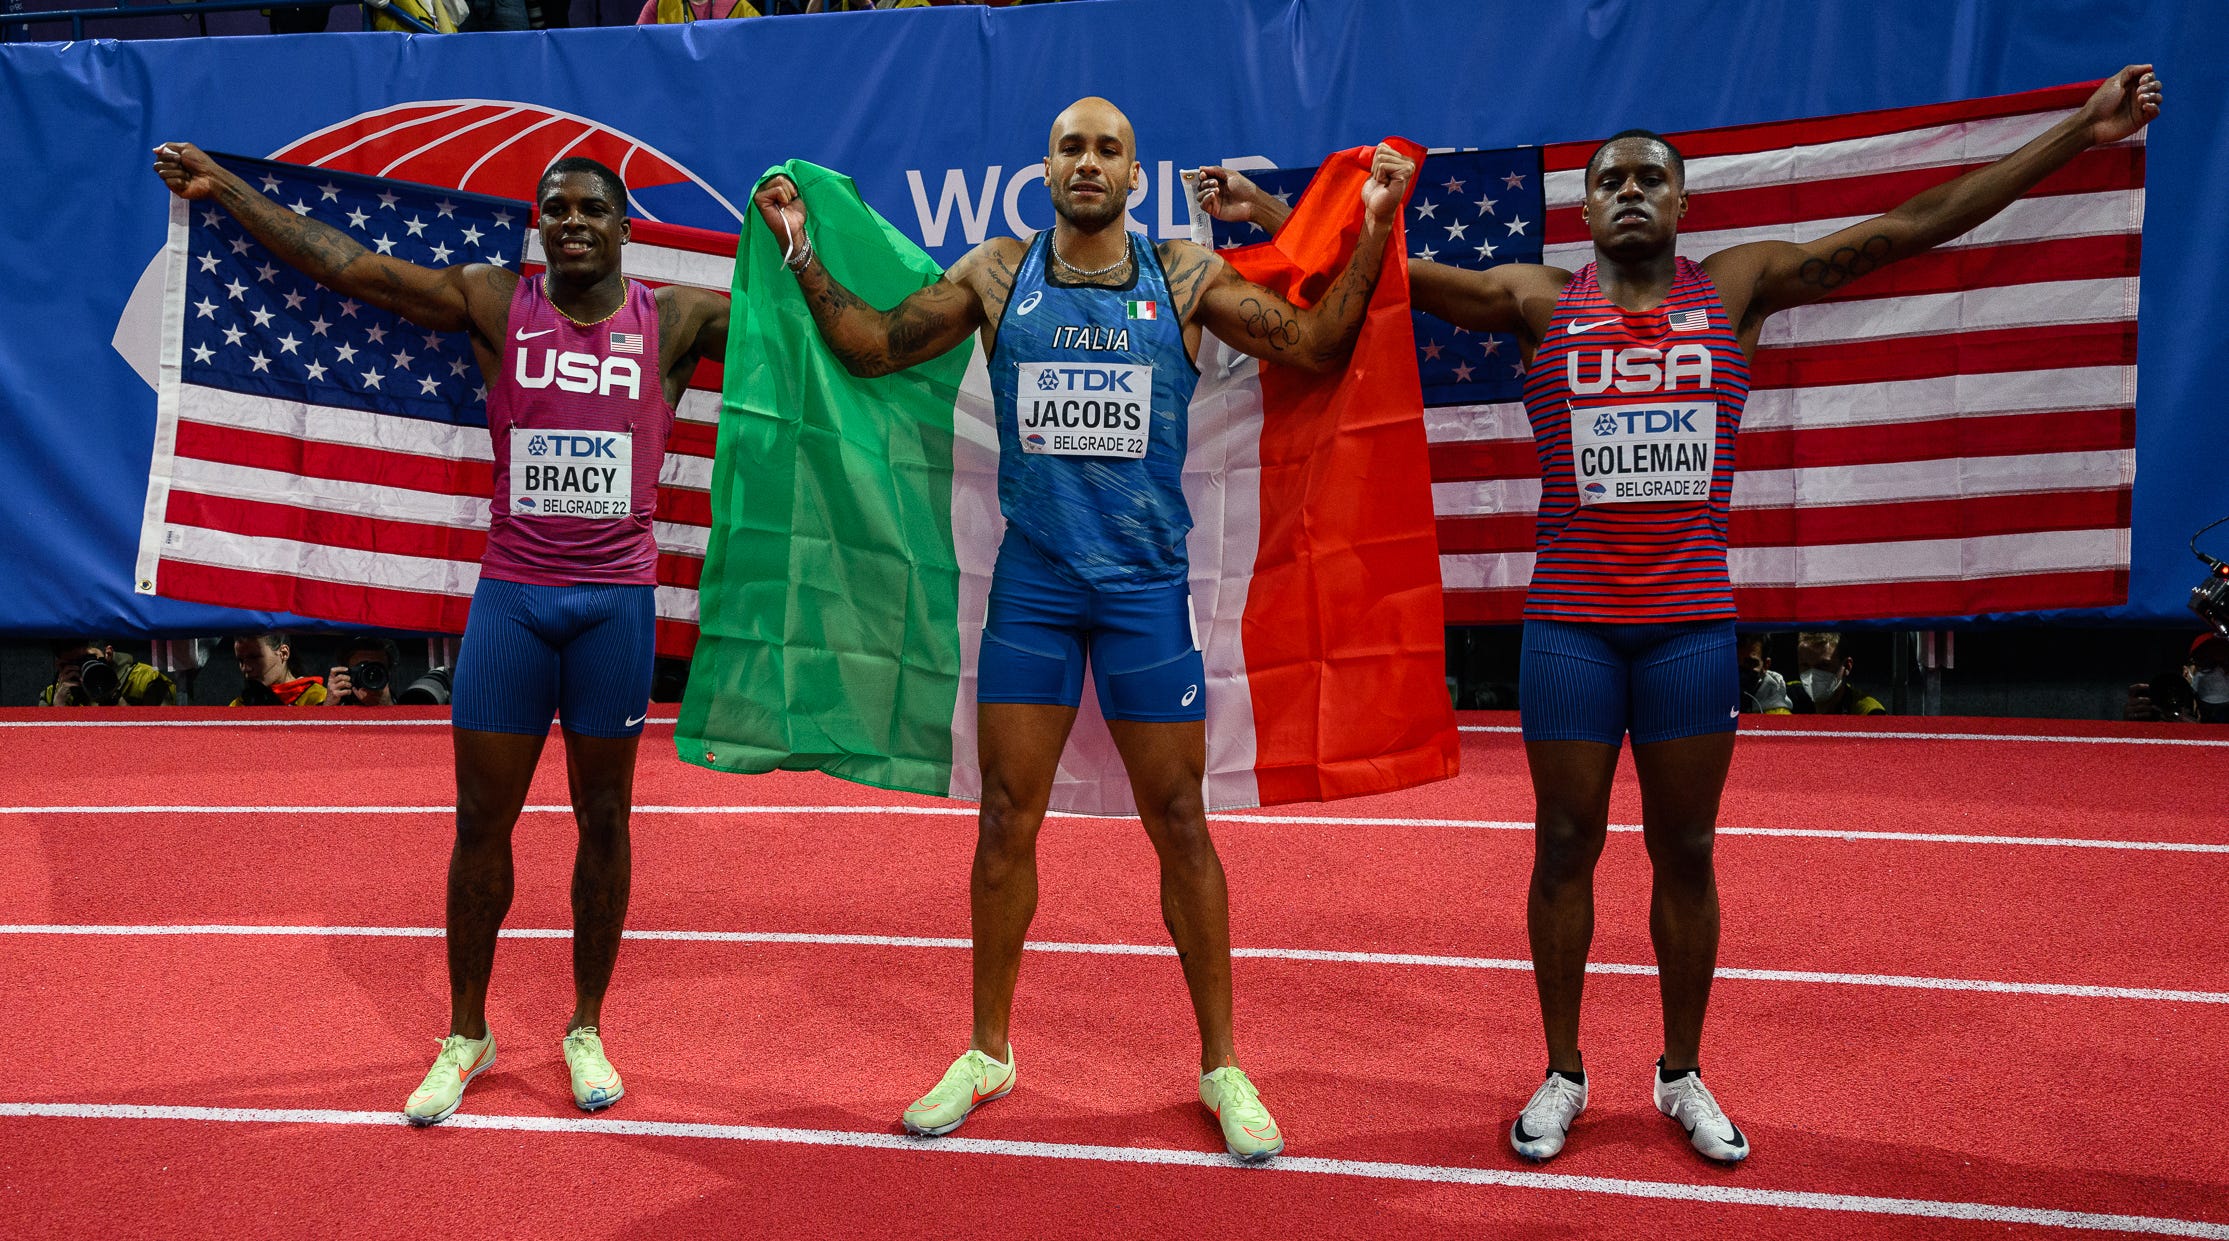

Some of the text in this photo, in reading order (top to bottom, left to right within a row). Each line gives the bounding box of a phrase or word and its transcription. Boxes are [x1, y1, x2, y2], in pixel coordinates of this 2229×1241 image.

[1051, 326, 1130, 351] ITALIA
[515, 347, 642, 400] USA
[1059, 369, 1134, 393] TDK
[1567, 343, 1712, 395] USA
[1025, 400, 1141, 431] JACOBS
[1616, 409, 1698, 434] TDK
[547, 435, 617, 459] TDK
[1054, 435, 1144, 454] BELGRADE 22
[1581, 443, 1707, 477] COLEMAN
[525, 465, 617, 494] BRACY
[1616, 480, 1707, 497] BELGRADE 22
[543, 499, 627, 515] BELGRADE 22
